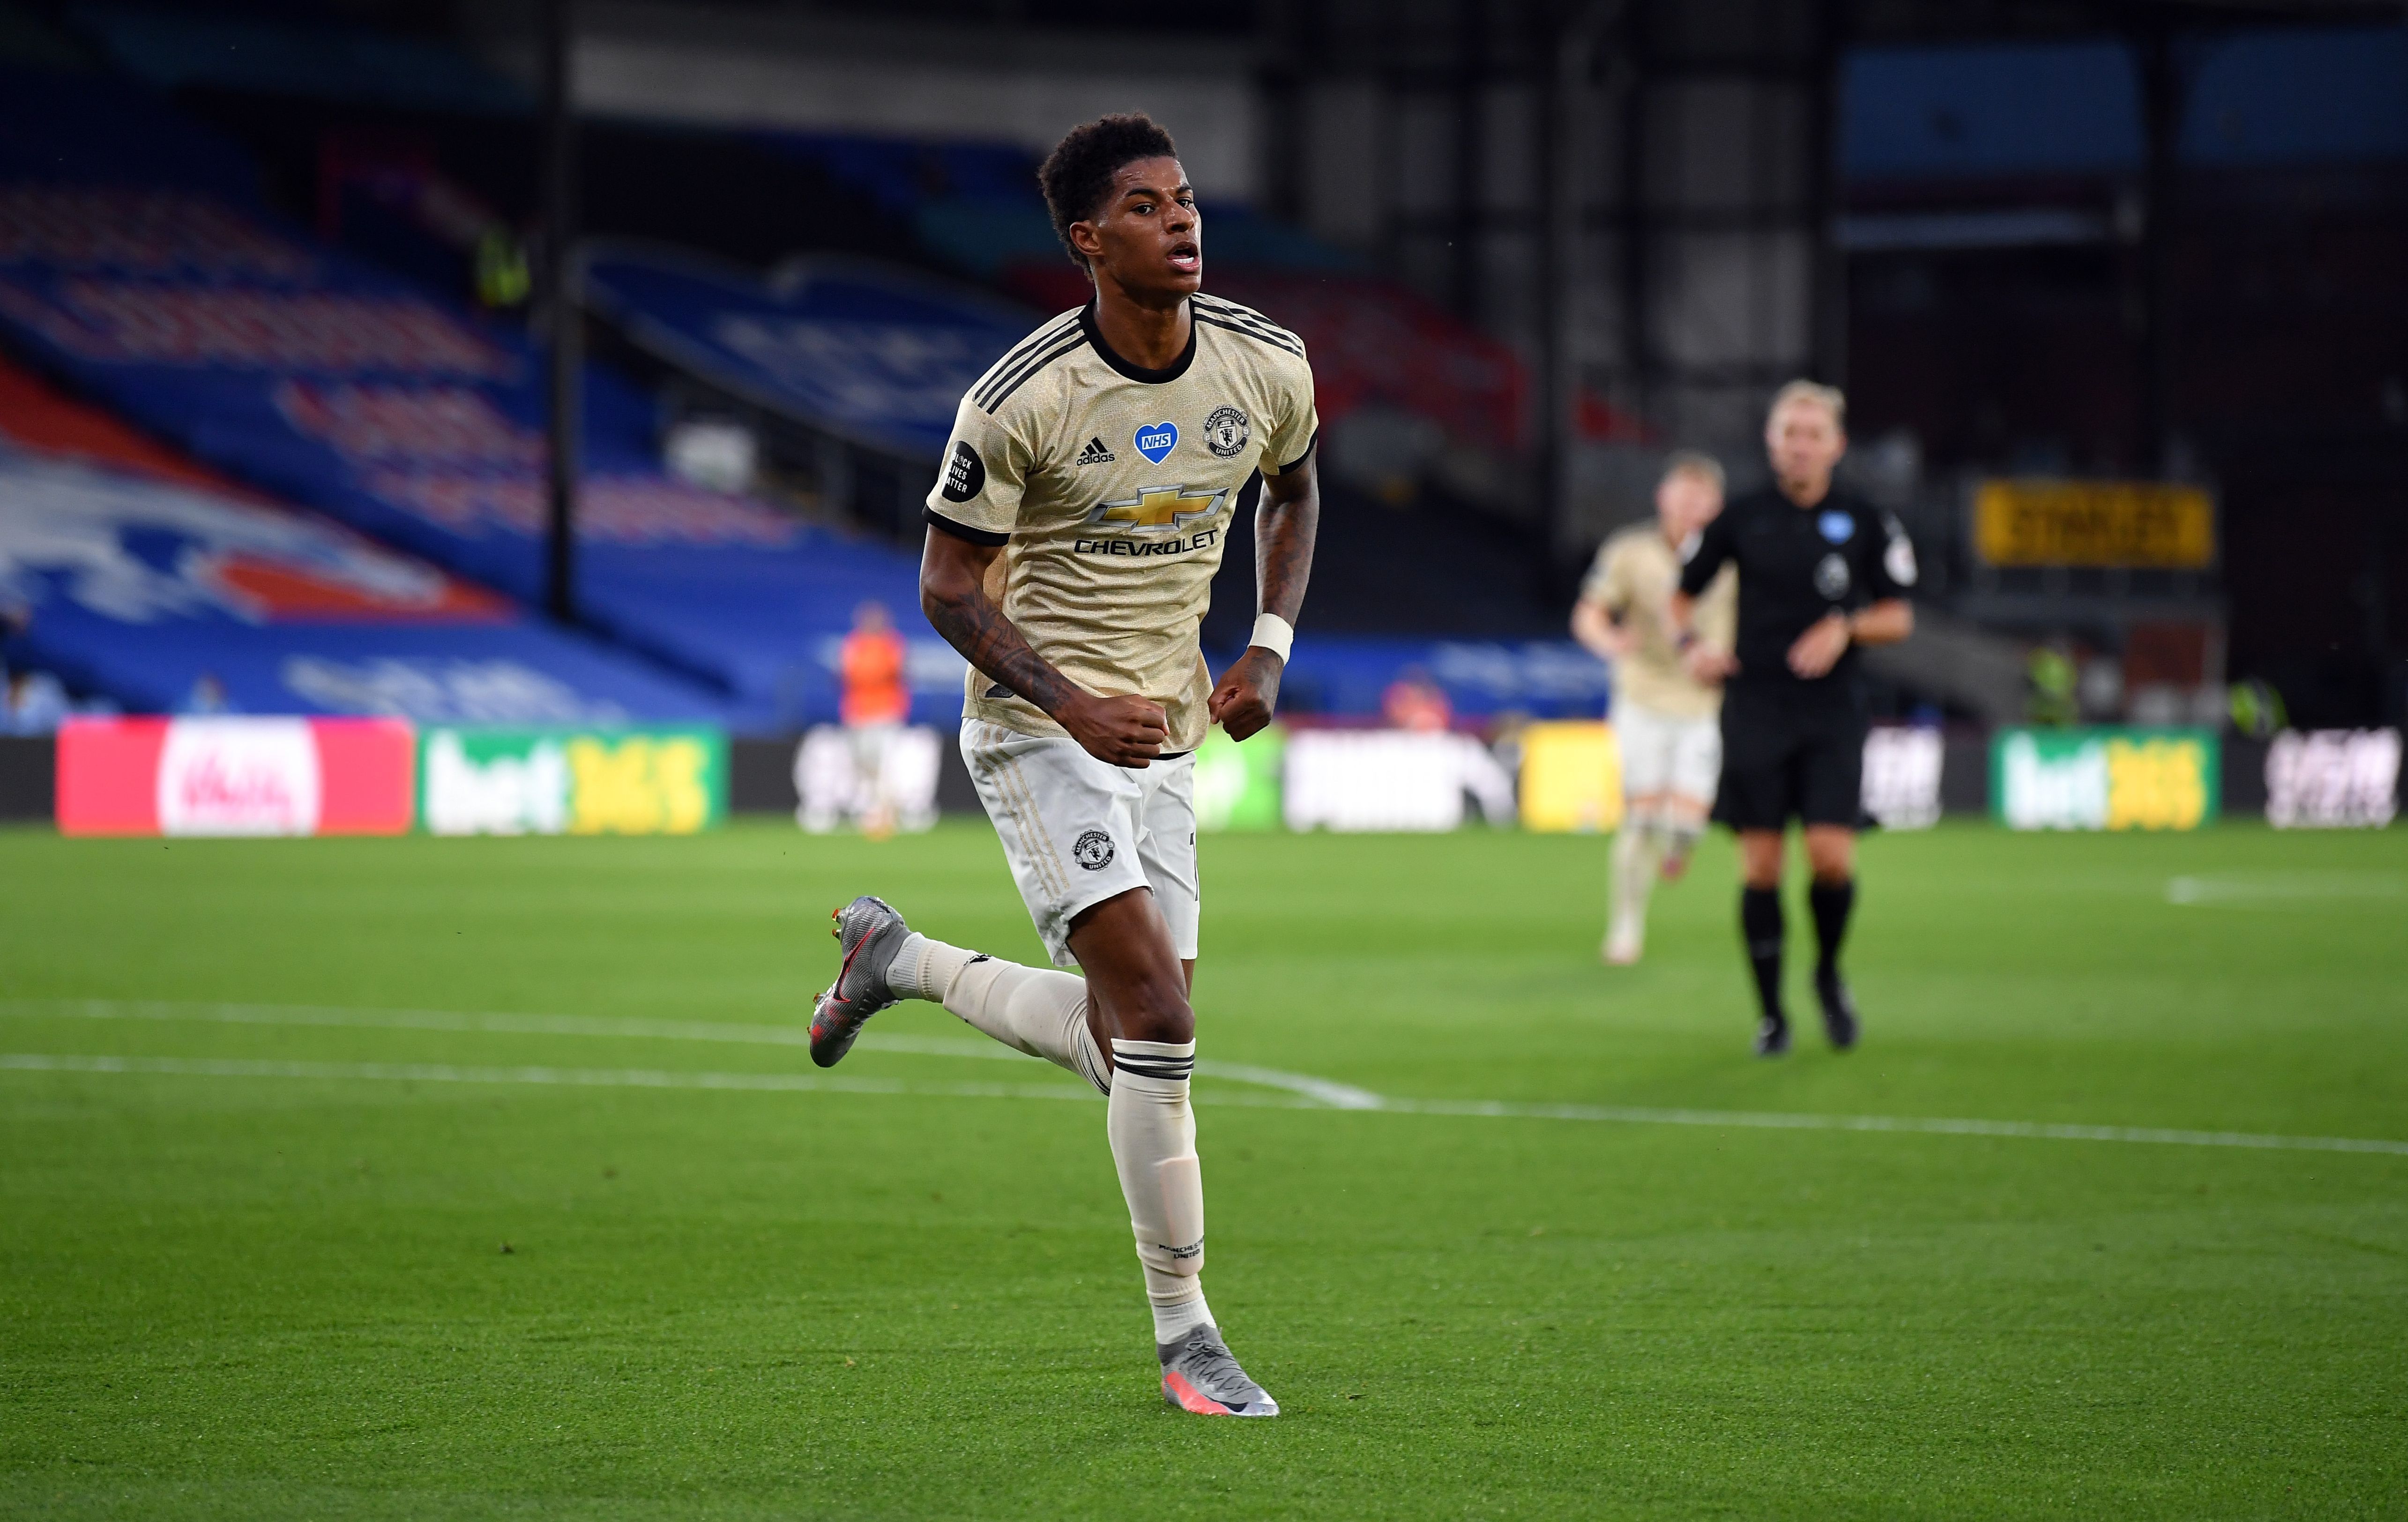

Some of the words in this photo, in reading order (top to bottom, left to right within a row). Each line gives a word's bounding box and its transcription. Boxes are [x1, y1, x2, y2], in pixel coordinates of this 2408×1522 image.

[1206, 409, 1245, 429] MANCHESTER
[1143, 434, 1169, 448] NHS
[1215, 444, 1242, 455] UNITED
[1076, 453, 1115, 466] adidas
[945, 476, 968, 493] ATTER
[1074, 529, 1218, 556] CHEVROLET
[1075, 832, 1107, 853] MANCHESTER
[1088, 855, 1111, 869] UNITED
